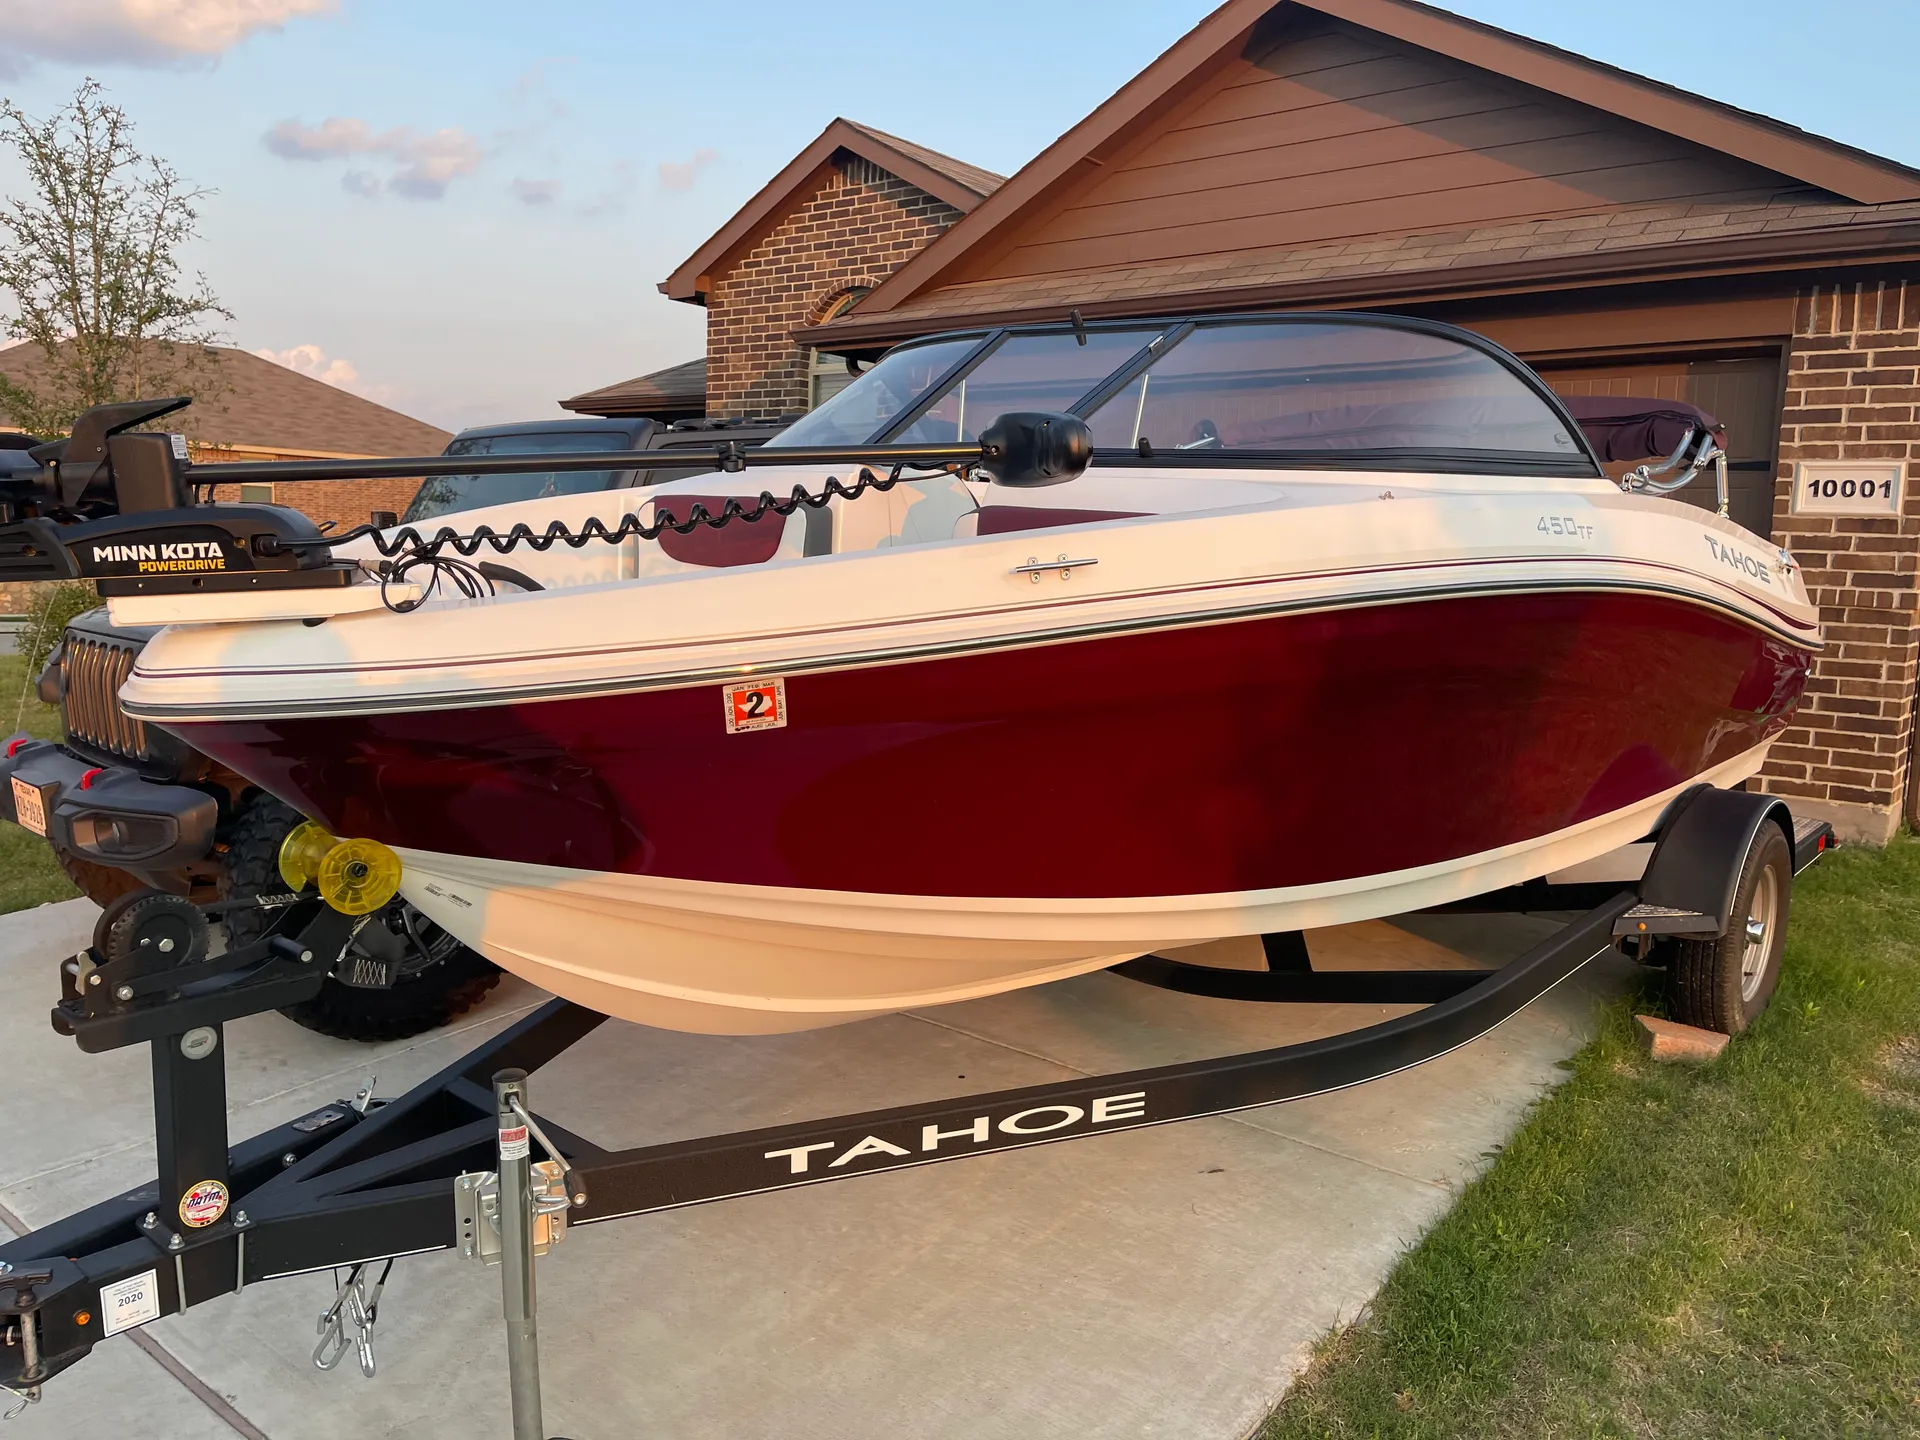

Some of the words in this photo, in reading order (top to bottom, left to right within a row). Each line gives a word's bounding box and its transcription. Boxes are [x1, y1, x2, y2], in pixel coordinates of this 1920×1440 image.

[1807, 479, 1892, 499] 10001
[93, 544, 157, 562] MINN
[161, 542, 223, 560] KOTA
[1704, 534, 1771, 585] TAHOE
[138, 559, 225, 572] POWERDRIVE
[746, 691, 765, 718] 2
[764, 1091, 1146, 1174] TAHOE
[117, 1291, 144, 1307] 2020
